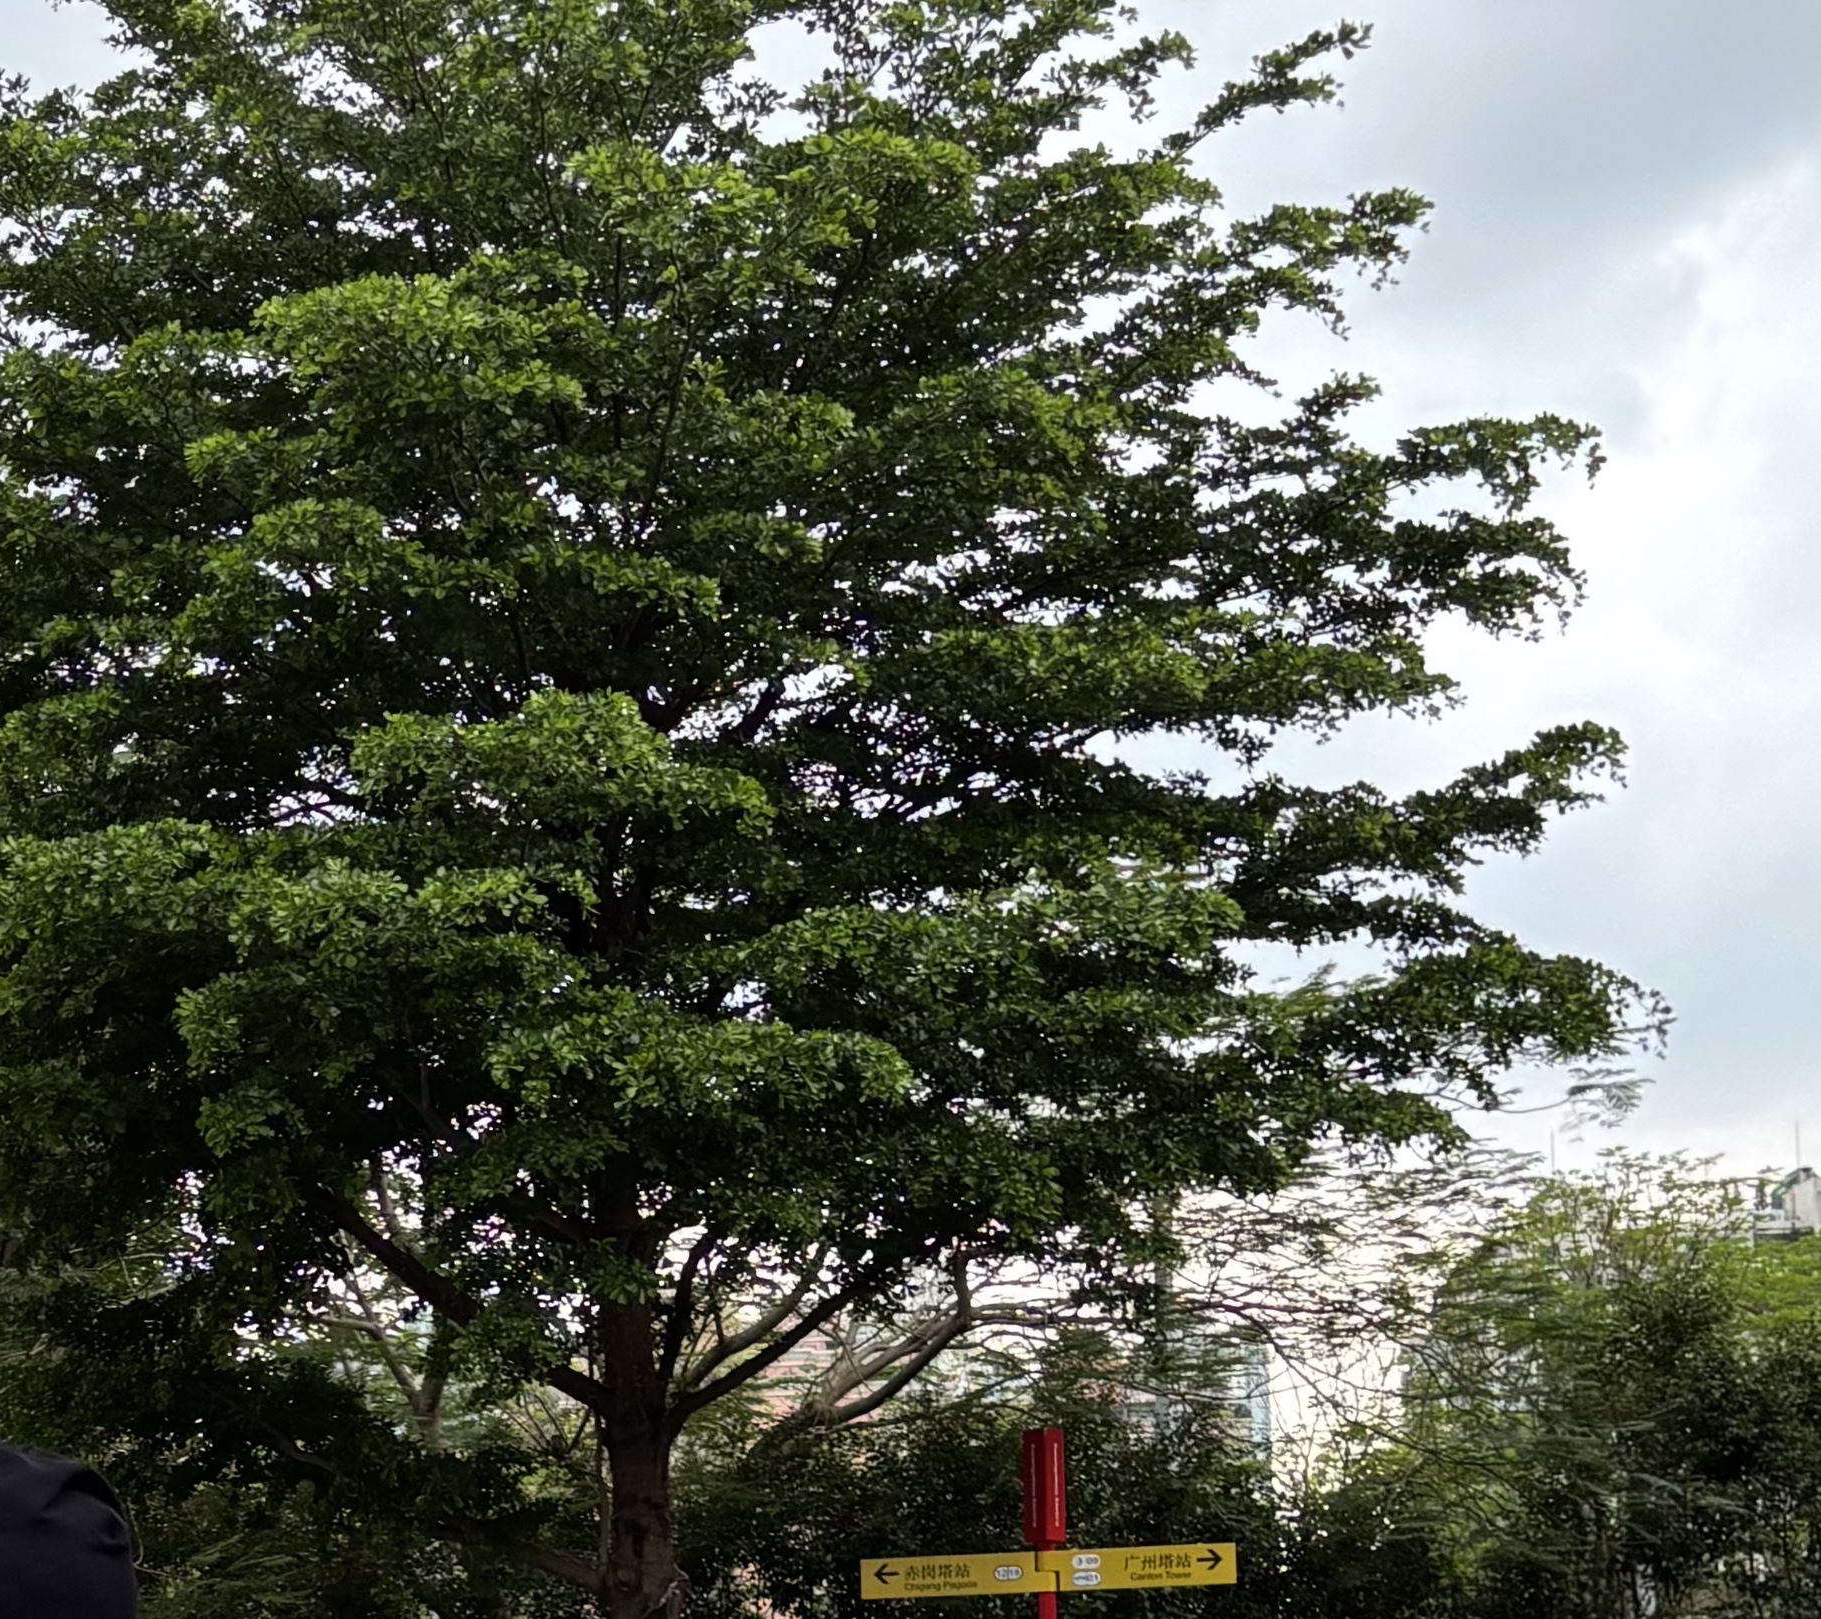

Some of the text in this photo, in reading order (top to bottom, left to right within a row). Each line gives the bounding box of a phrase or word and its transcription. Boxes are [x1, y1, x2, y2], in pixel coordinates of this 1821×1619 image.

[1124, 1553, 1192, 1571] 广州塔站
[904, 1563, 971, 1581] 赤岗塔站
[1130, 1570, 1192, 1581] Canton Tower
